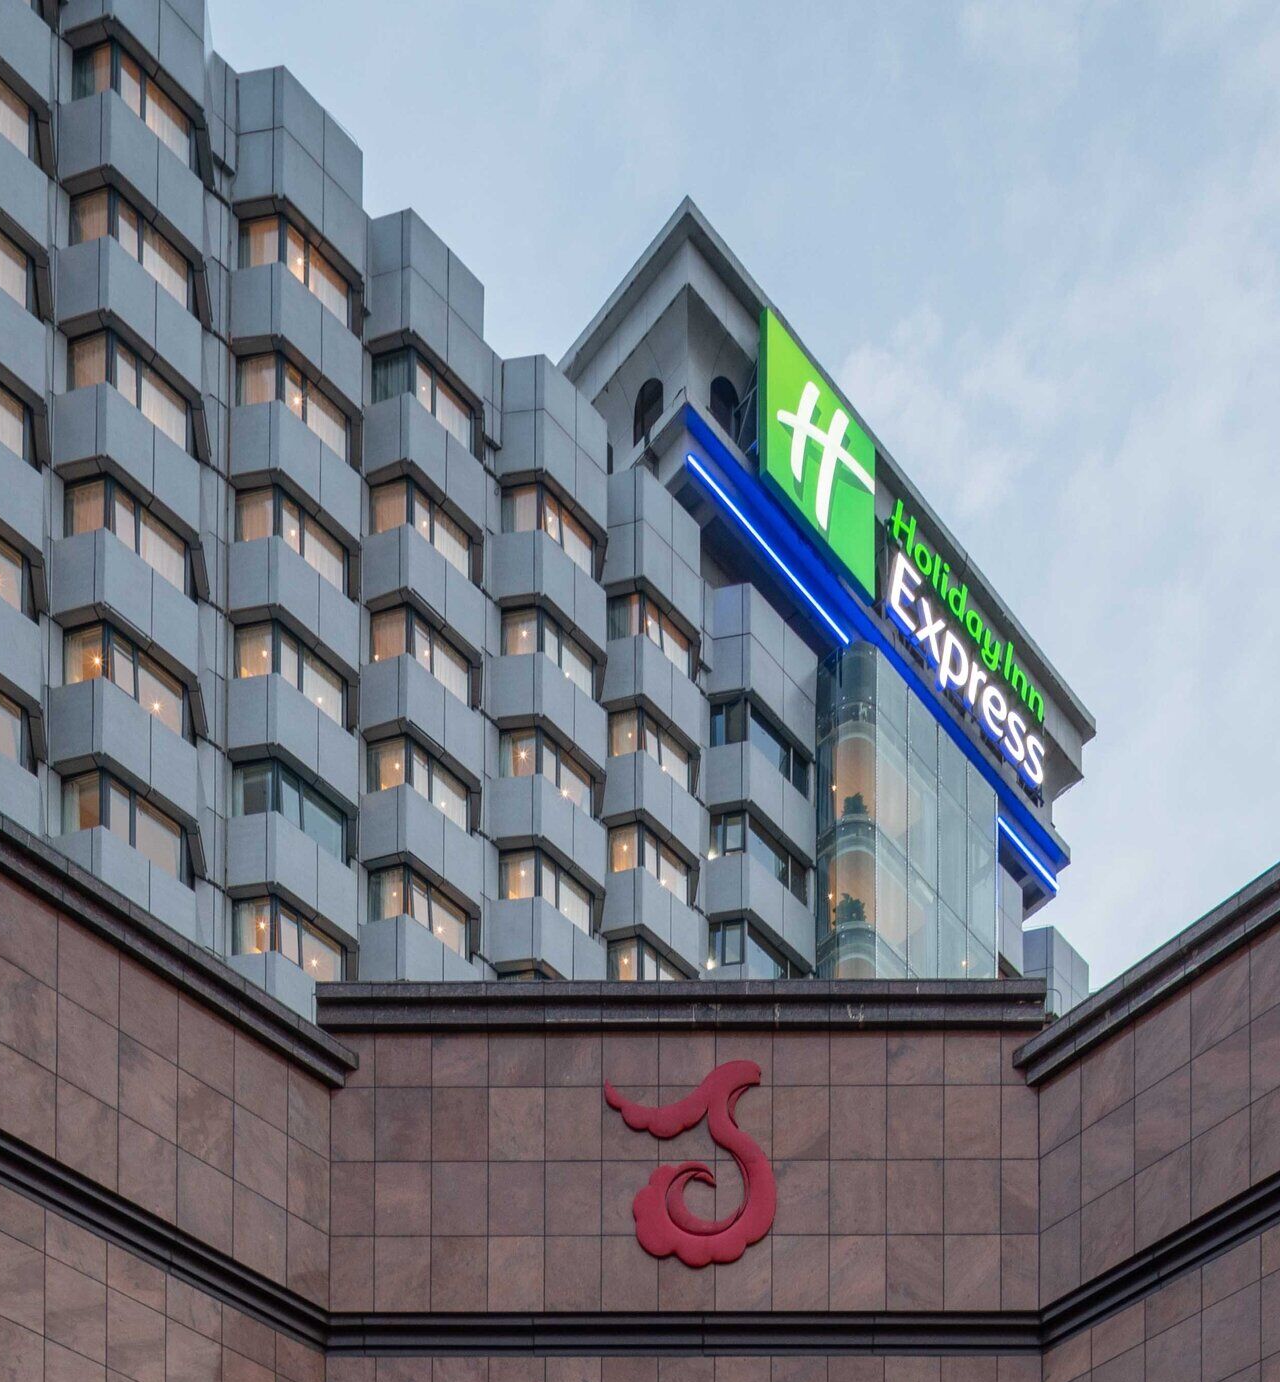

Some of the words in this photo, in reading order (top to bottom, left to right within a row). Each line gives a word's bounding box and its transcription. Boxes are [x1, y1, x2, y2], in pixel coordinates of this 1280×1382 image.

[887, 551, 1046, 787] Express
[889, 498, 1005, 675] Holiday
[1003, 641, 1046, 724] Inn
